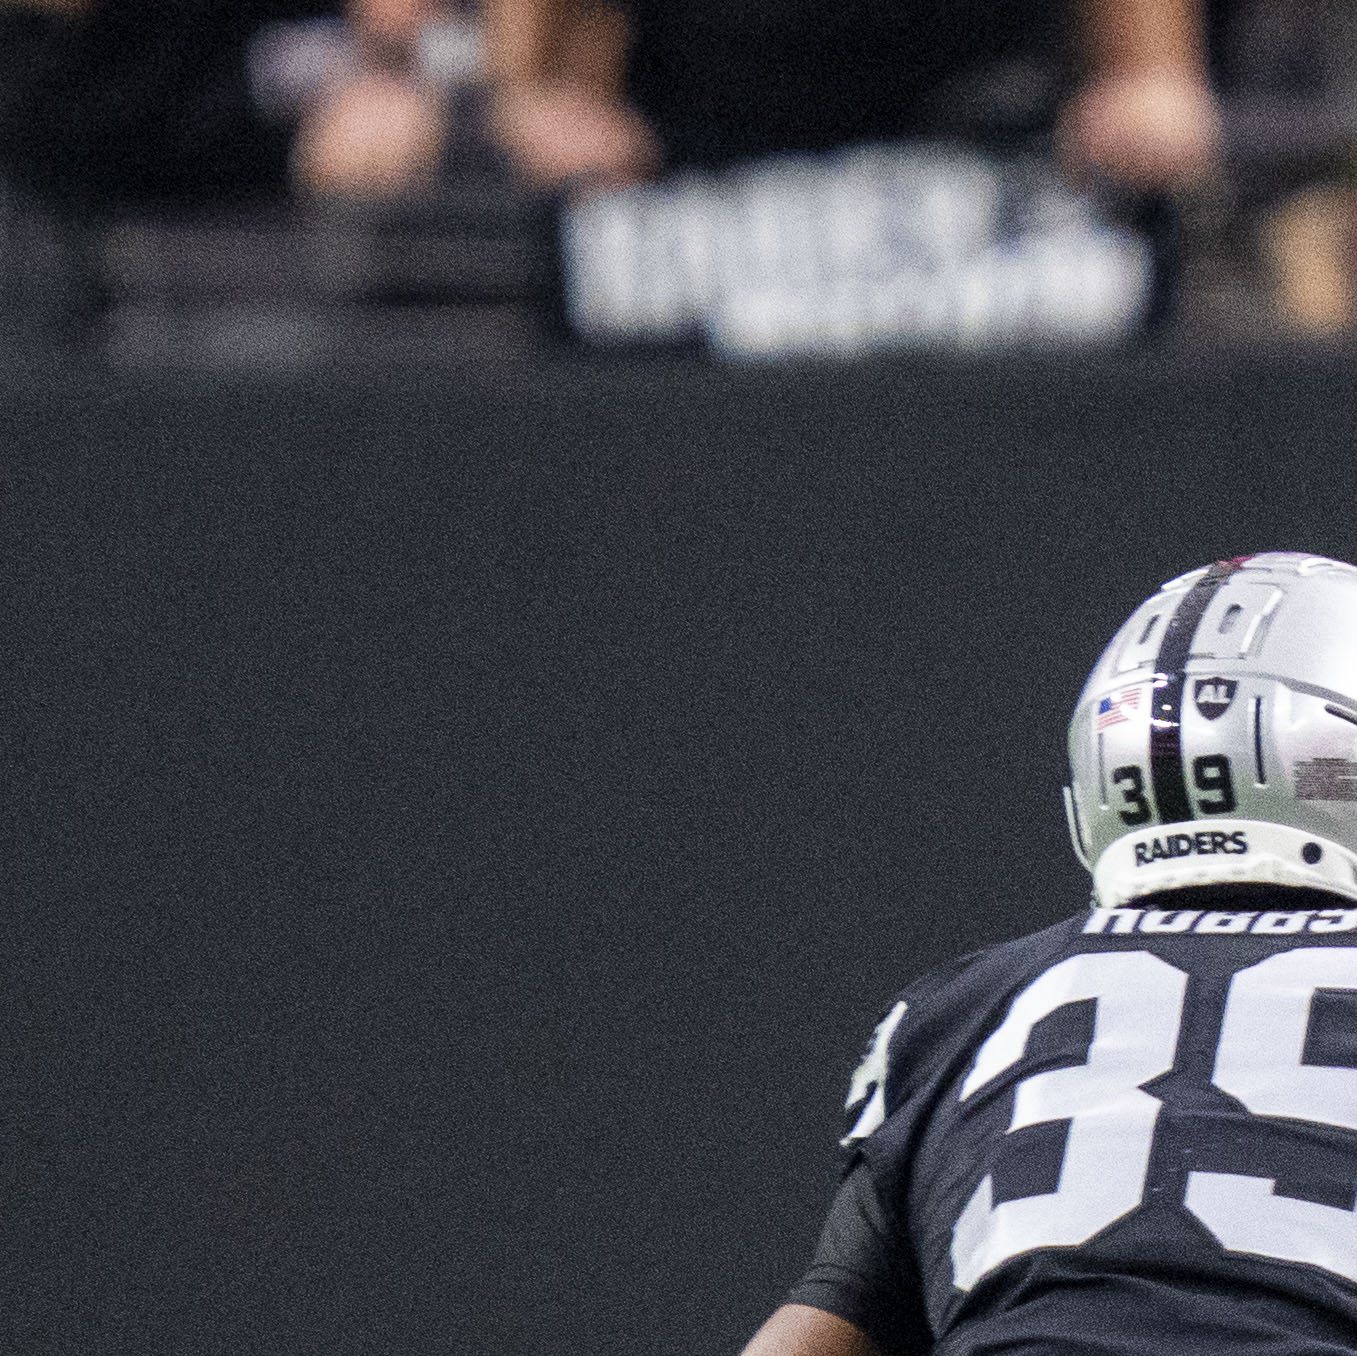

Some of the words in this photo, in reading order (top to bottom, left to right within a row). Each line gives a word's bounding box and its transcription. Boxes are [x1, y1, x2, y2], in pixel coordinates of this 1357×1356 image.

[1197, 684, 1230, 703] AL
[1112, 753, 1237, 826] 39
[1134, 831, 1249, 867] RAIDERS
